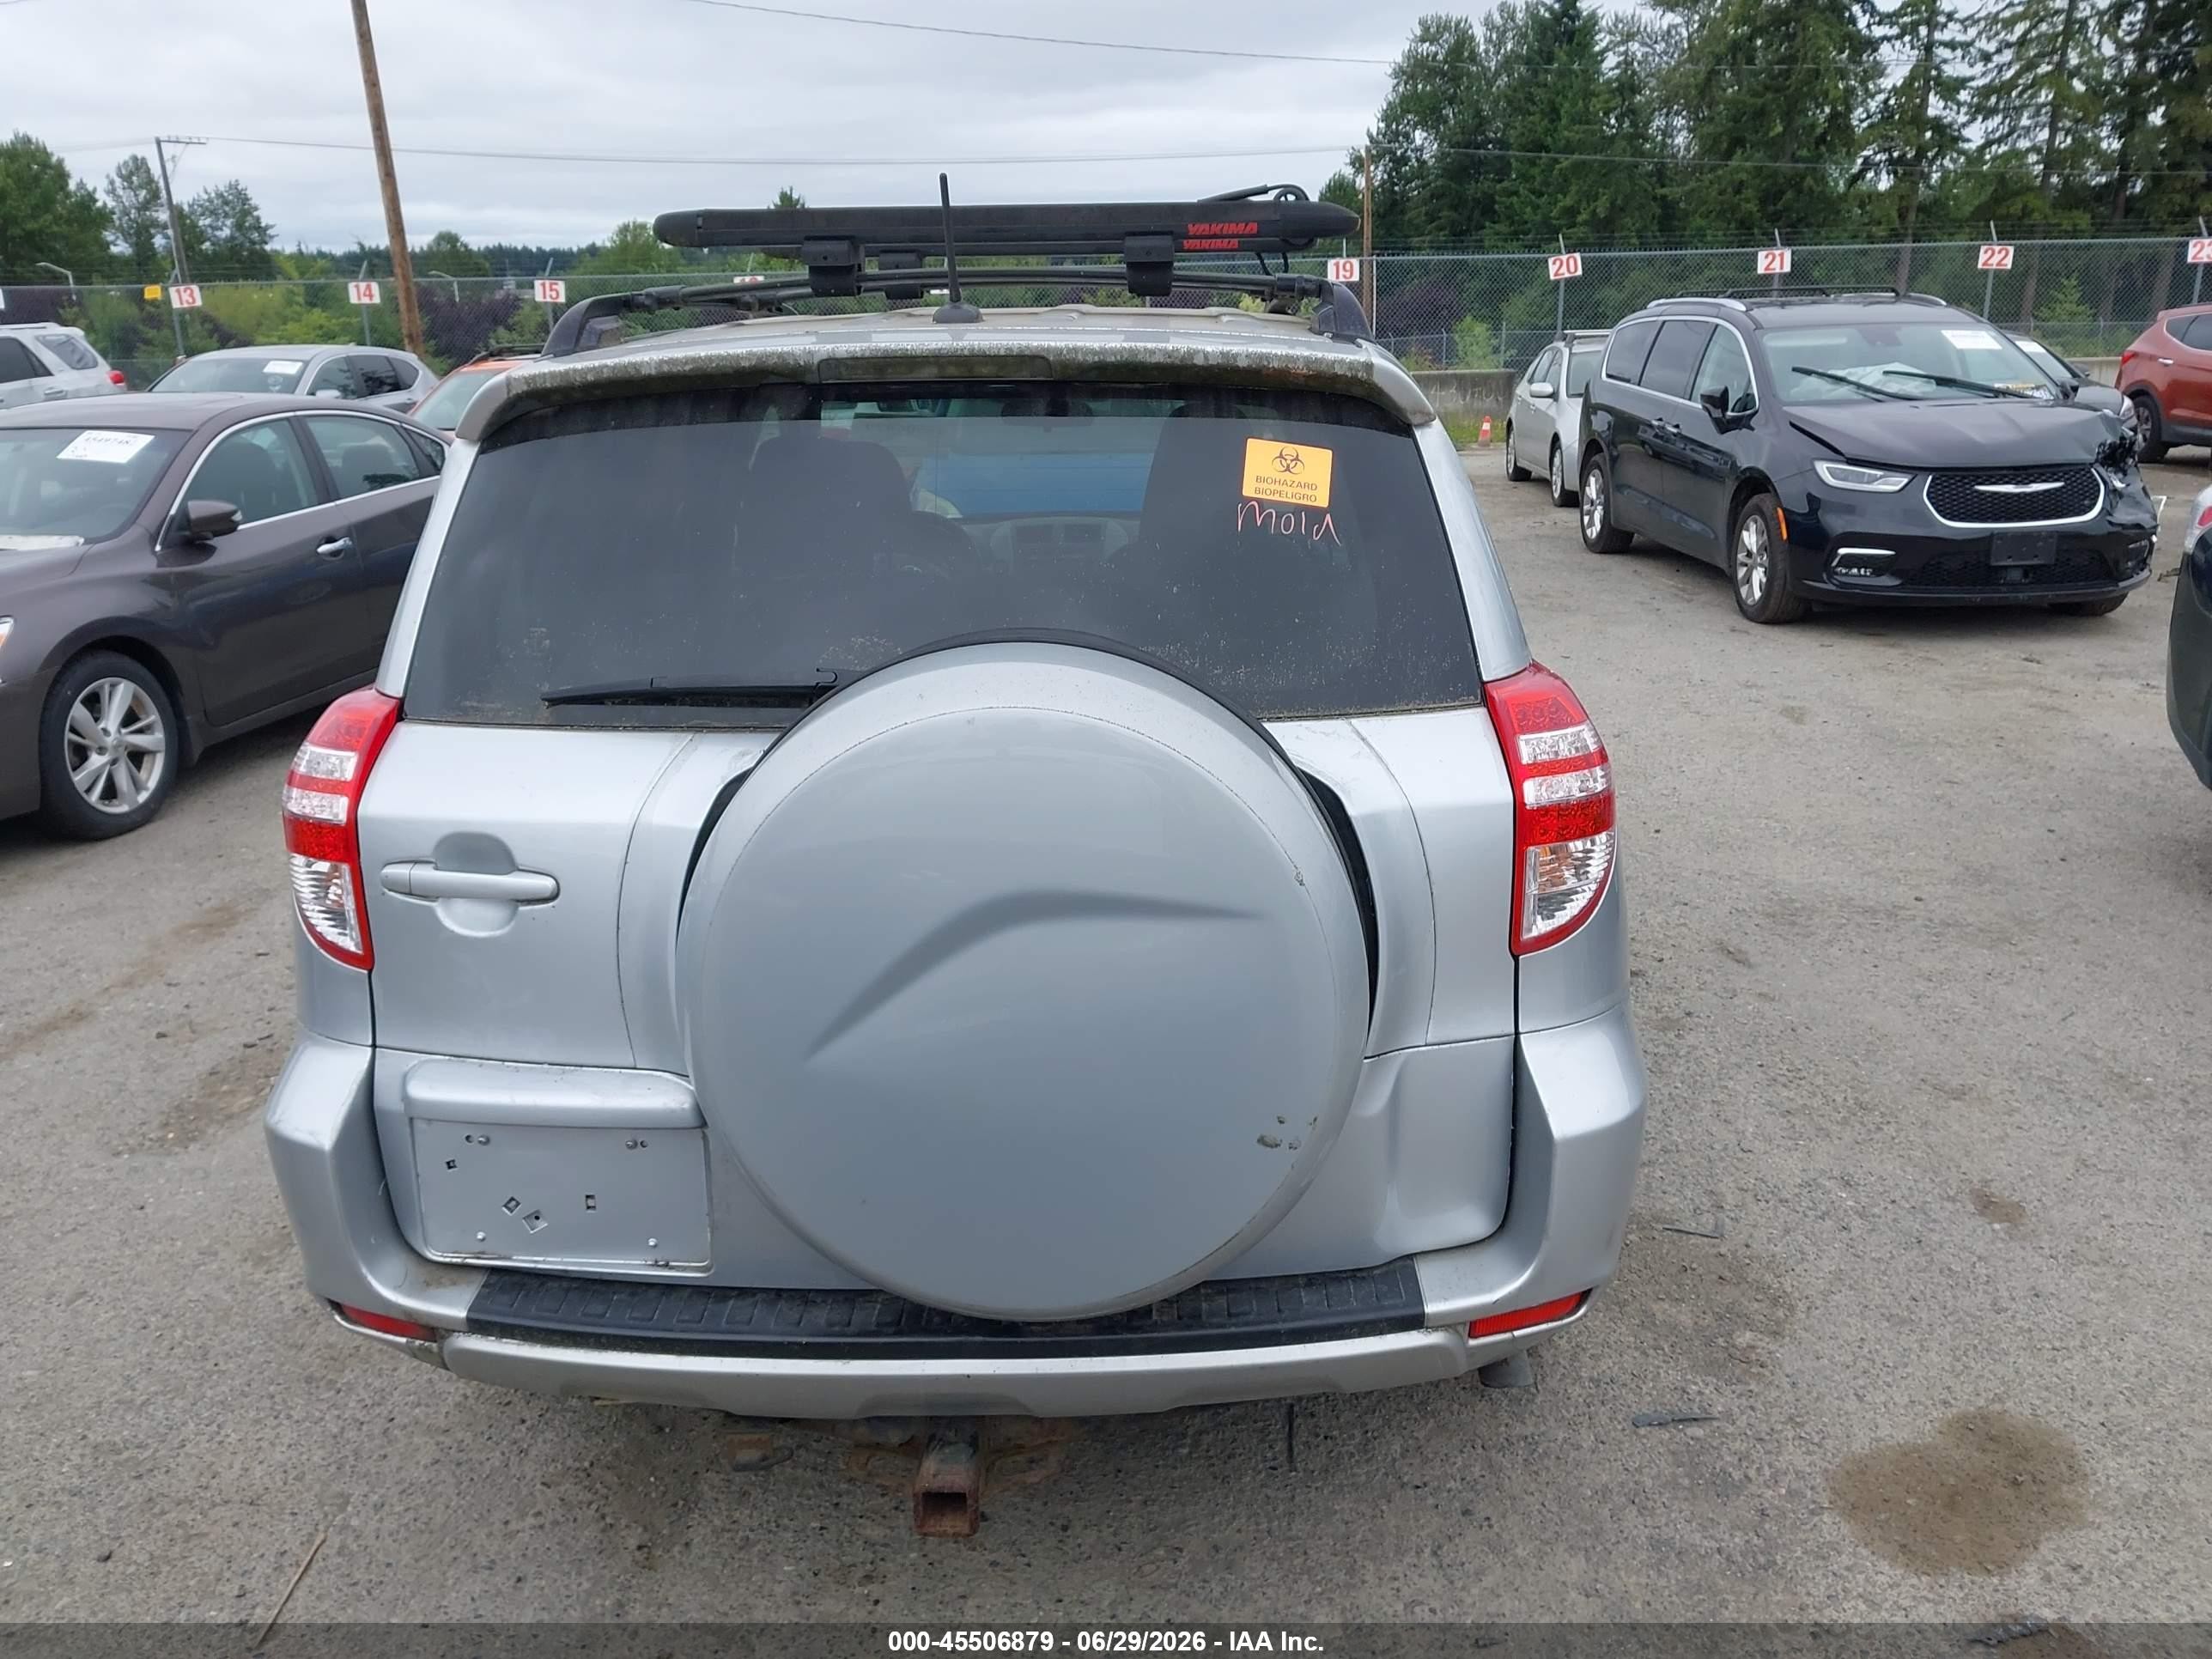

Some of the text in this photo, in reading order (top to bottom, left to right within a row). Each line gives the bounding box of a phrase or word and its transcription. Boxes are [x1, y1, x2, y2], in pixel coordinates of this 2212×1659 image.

[1188, 222, 1258, 234] YAKIMA
[1183, 239, 1239, 249] YAKIMA
[1552, 255, 1578, 278] 20
[1763, 252, 1787, 274] 21
[1981, 246, 2010, 269] 22
[1334, 261, 1355, 280] 19
[175, 287, 197, 306] 13
[354, 283, 375, 304] 14
[541, 282, 560, 302] 15
[1255, 475, 1318, 491] BIOHAZARD
[1254, 486, 1317, 503] BIOPELIGRO
